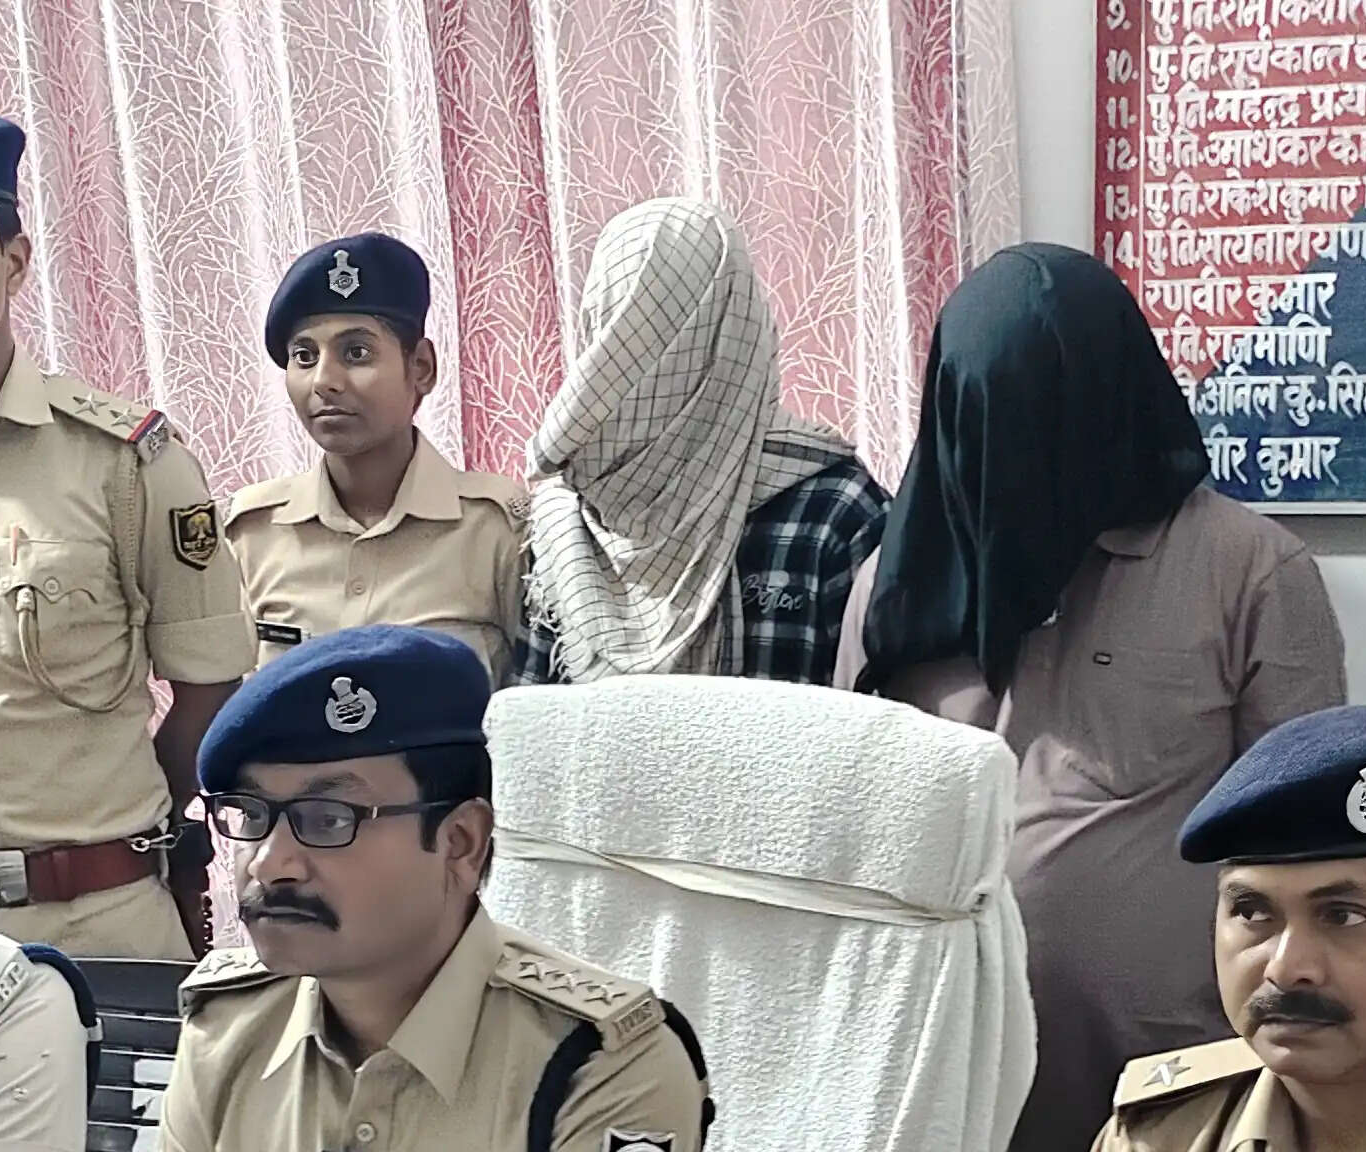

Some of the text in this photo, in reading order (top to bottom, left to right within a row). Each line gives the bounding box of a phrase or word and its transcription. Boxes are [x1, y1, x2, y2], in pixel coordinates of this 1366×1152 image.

[1106, 49, 1138, 83] 10.
[1106, 97, 1137, 129] 11.
[1106, 137, 1138, 171] 12.
[1143, 264, 1243, 320] रणवीर
[1248, 272, 1338, 325] कुमार
[1257, 436, 1342, 497] कुमार
